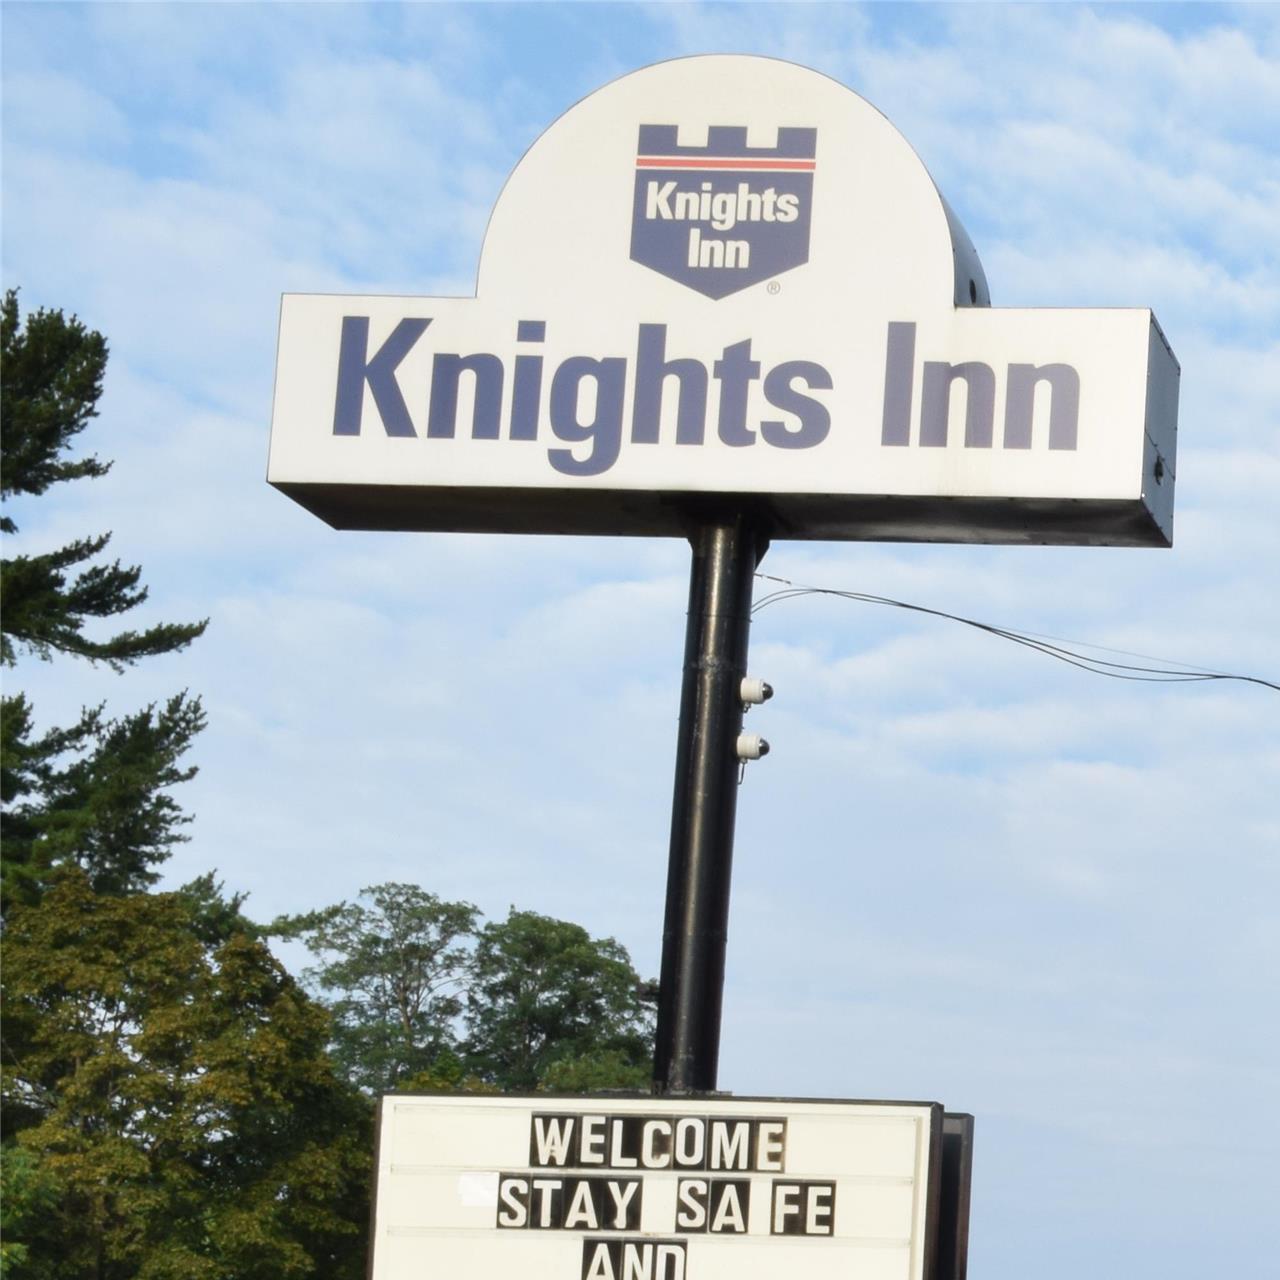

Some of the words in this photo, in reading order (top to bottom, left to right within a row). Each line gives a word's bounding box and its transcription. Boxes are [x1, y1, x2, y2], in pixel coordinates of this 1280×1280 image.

[646, 181, 799, 231] Knights
[688, 228, 750, 268] Inn
[332, 315, 833, 477] Knights
[881, 321, 1080, 452] Inn
[534, 1115, 784, 1171] WELCOME
[499, 1178, 640, 1230] STAY
